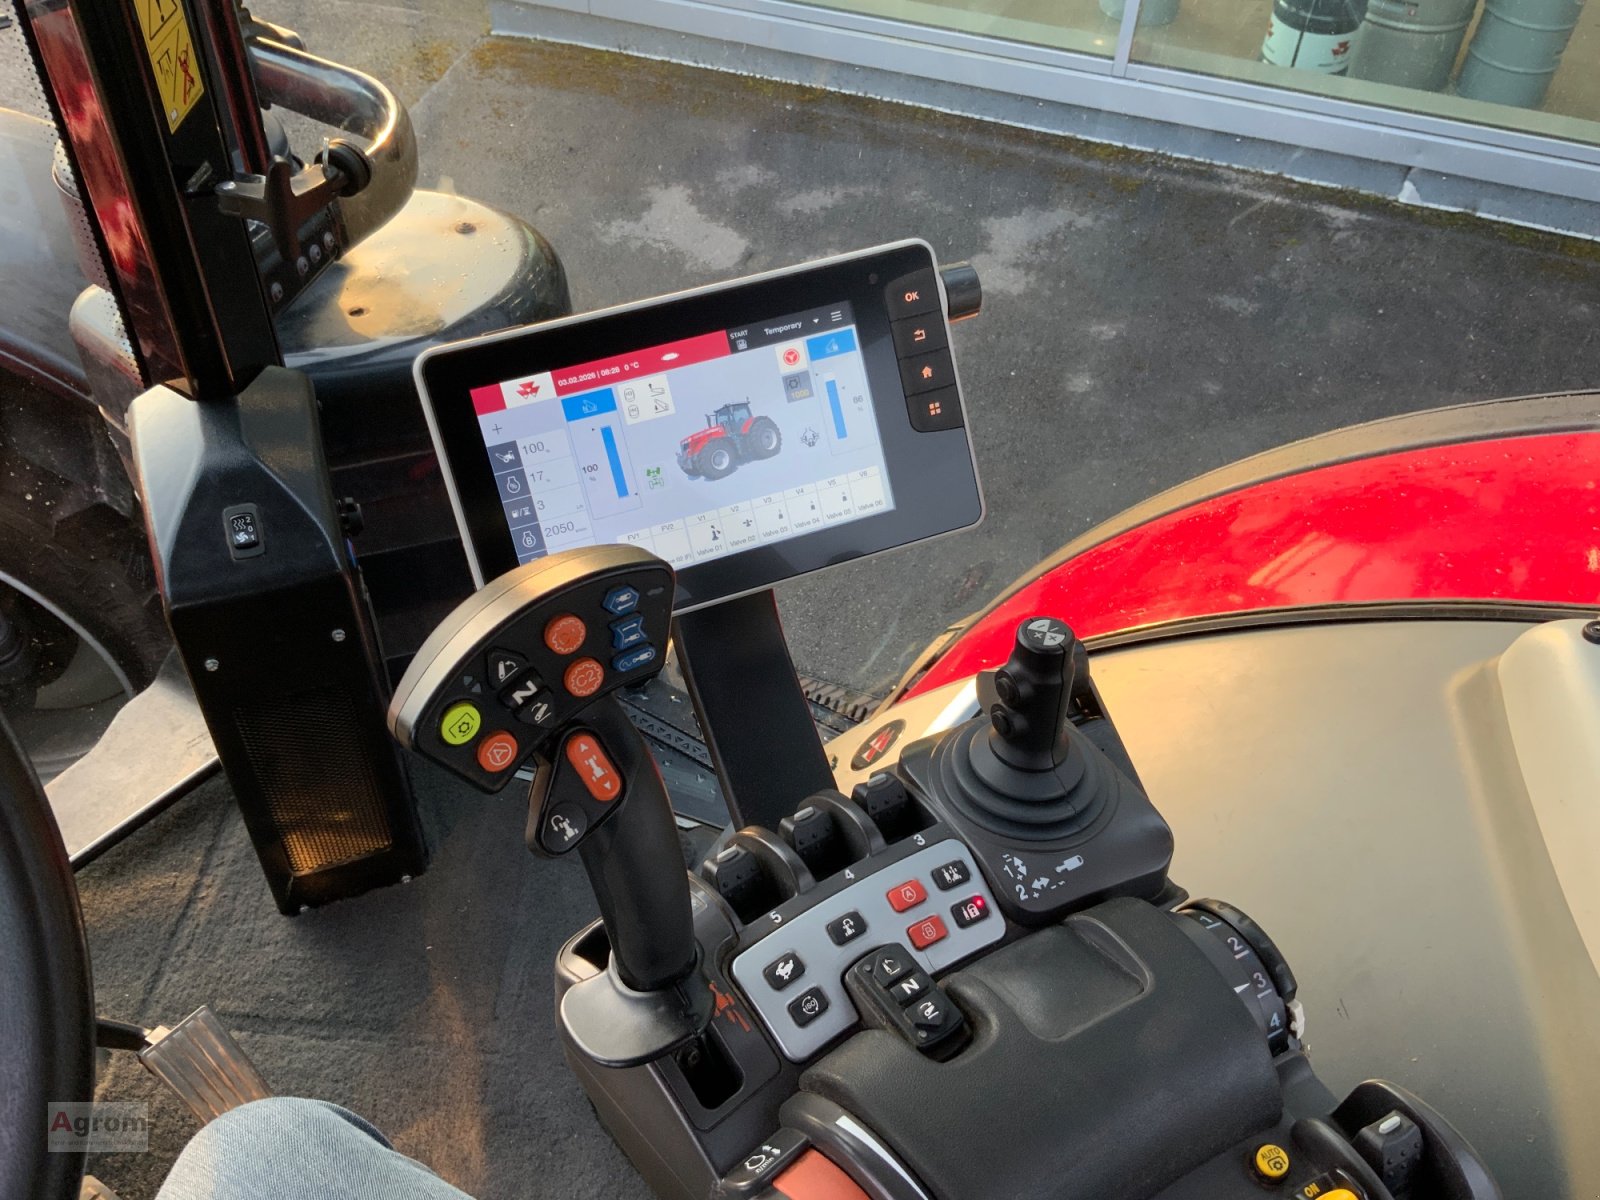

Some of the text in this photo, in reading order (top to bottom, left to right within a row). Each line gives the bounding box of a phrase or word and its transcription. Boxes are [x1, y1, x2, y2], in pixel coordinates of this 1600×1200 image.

[905, 291, 919, 302] OK
[730, 330, 748, 339] START
[764, 321, 802, 336] Temporary
[522, 441, 544, 456] 100
[581, 463, 599, 474] 100
[529, 471, 544, 483] 17
[537, 500, 545, 510] 3
[730, 505, 740, 513] V2
[858, 502, 874, 511] Valve
[826, 511, 843, 520] Valve
[544, 521, 574, 537] 2050
[795, 520, 811, 529] Valve
[762, 528, 779, 538] Valve
[729, 538, 747, 547] Valve
[697, 547, 714, 557] Valve
[576, 669, 595, 687] C2
[512, 680, 538, 705] N
[913, 833, 926, 846] 3
[844, 869, 855, 880] 4
[1003, 864, 1015, 878] 1
[905, 889, 914, 899] A
[1015, 884, 1029, 901] 2
[769, 910, 782, 924] 5
[1200, 915, 1213, 923] 1
[1227, 937, 1243, 951] 2
[1253, 972, 1267, 988] 3
[901, 978, 920, 995] N
[804, 999, 817, 1011] ISO
[1270, 1012, 1281, 1027] 4
[1260, 1147, 1281, 1161] AUTO
[755, 1157, 775, 1173] n/min
[1304, 1182, 1321, 1198] ON
